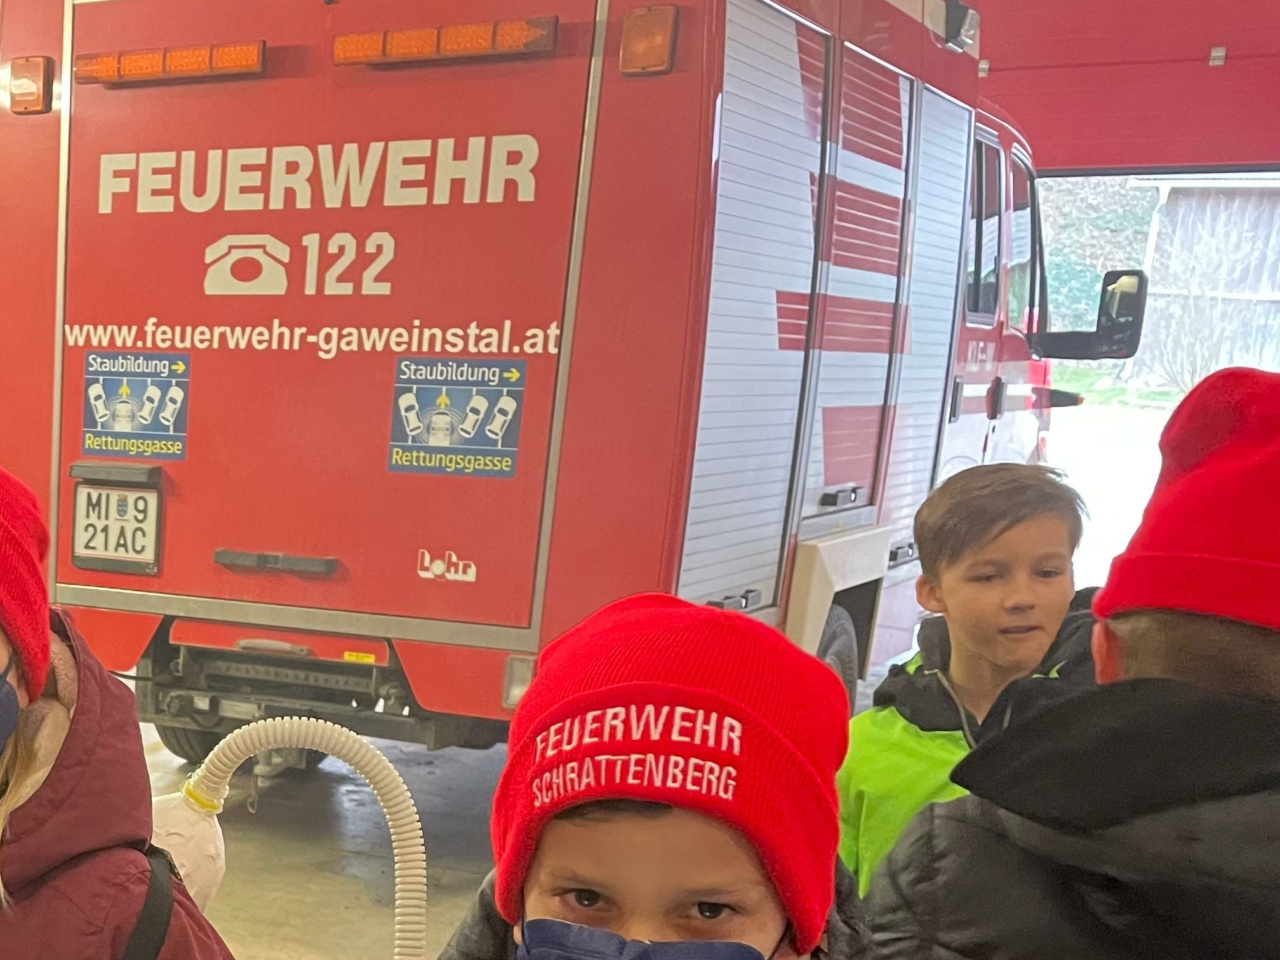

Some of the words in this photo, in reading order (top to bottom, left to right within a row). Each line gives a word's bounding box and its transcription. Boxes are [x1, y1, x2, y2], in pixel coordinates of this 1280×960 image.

[99, 134, 539, 214] FEUERWEHR
[302, 231, 395, 295] 122
[64, 318, 559, 358] www.feuerwehr-gaweinstal.at
[88, 354, 170, 377] Staubildung
[400, 361, 500, 385] Staubildung
[85, 433, 182, 456] Rettungsgasse
[392, 447, 512, 472] Rettungsgasse
[86, 491, 110, 520] MI
[134, 495, 148, 524] 9
[417, 548, 477, 582] Lohr
[535, 704, 743, 763] FEUERWEHR
[533, 753, 738, 807] SCHRATTENBERG
